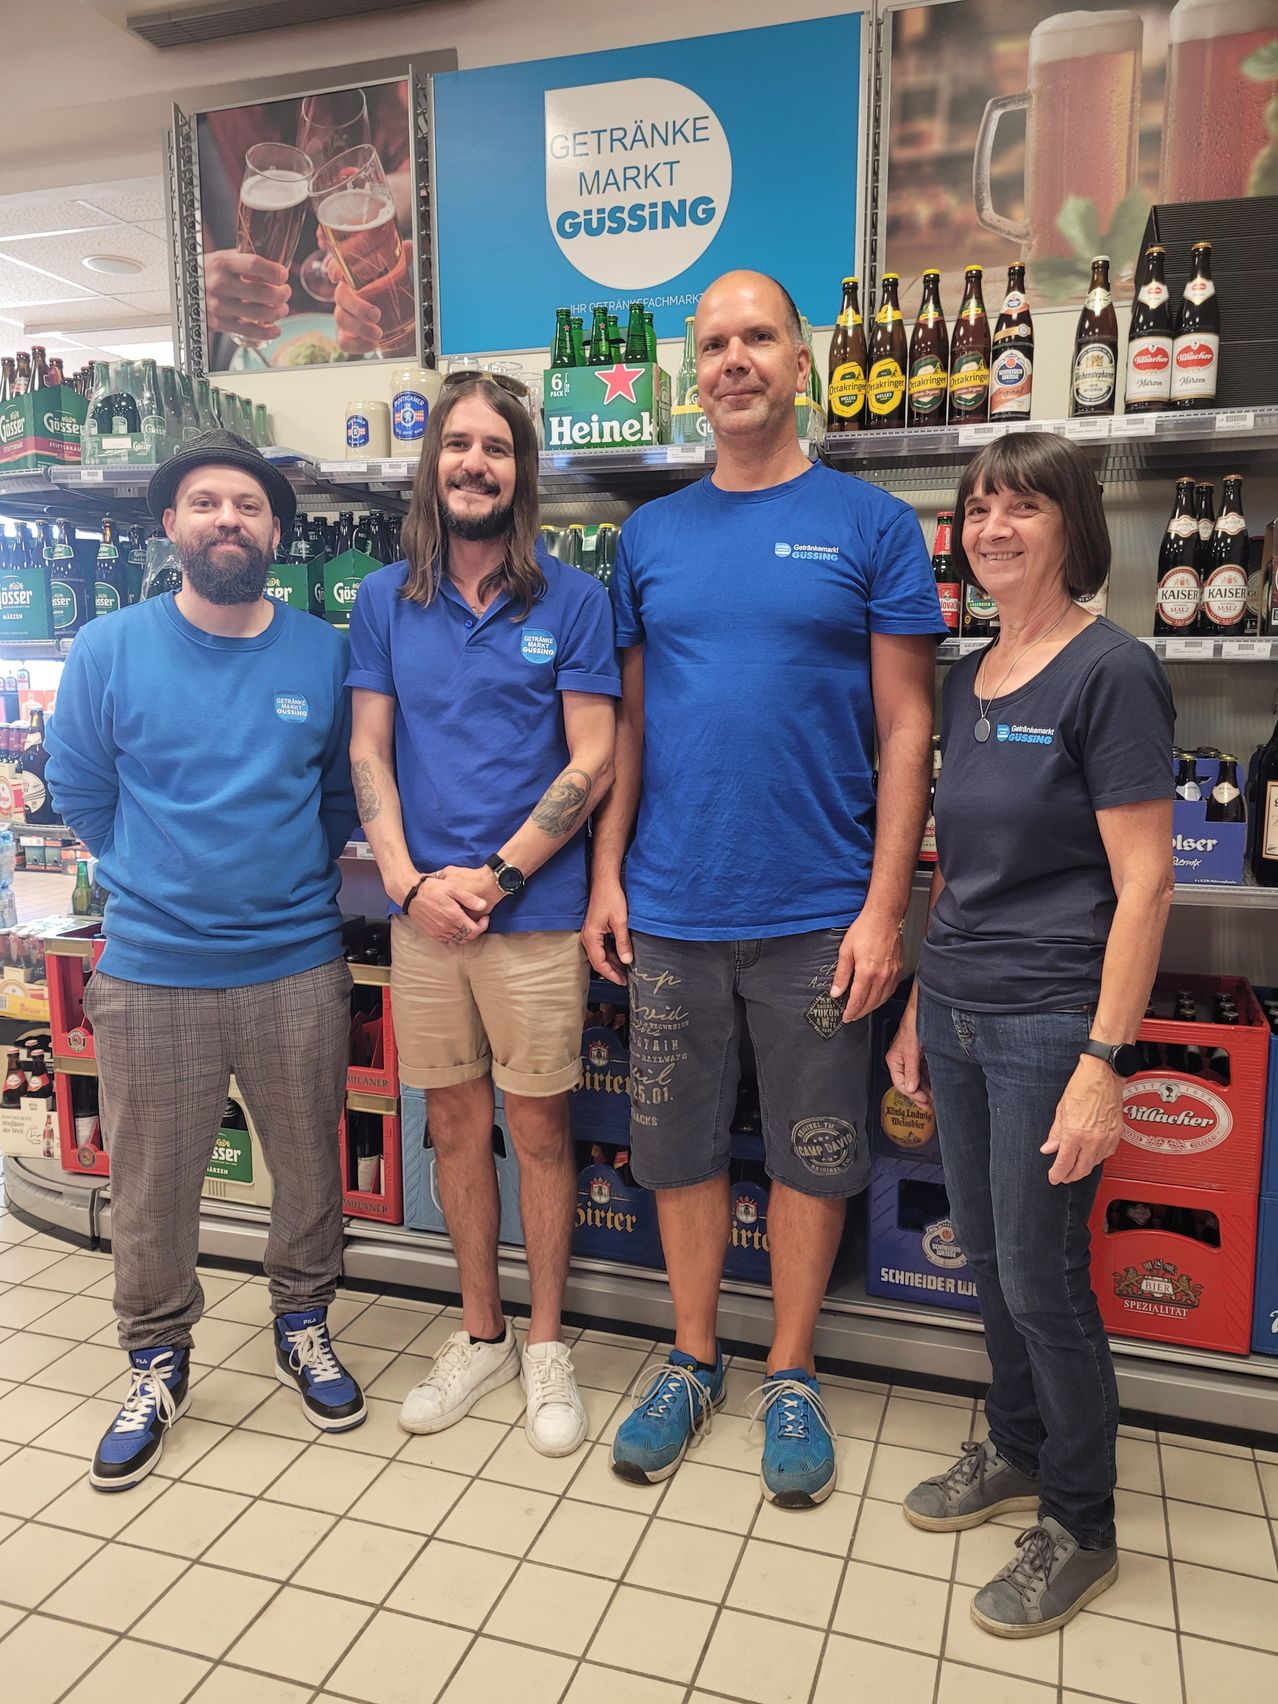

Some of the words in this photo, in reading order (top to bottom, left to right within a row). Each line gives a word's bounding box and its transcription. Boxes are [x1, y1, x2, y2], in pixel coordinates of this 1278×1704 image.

[550, 115, 710, 160] GETRÄNKE
[579, 160, 680, 196] MARKT
[570, 304, 587, 315] IHR
[551, 373, 562, 390] 6
[793, 543, 840, 554] Getränkemarkt
[1161, 589, 1199, 601] KAISER
[1207, 587, 1247, 599] KAISER
[1216, 604, 1238, 612] MALZ
[523, 635, 554, 644] GETRÄNKE
[527, 641, 550, 649] MARKT
[1011, 725, 1055, 735] Getränkemarkt
[813, 1008, 840, 1018] YUKON
[1123, 1104, 1214, 1128] Villacher
[798, 1145, 823, 1156] CAMP
[824, 1133, 853, 1153] DAVID
[881, 1268, 955, 1294] SCHNEIDER
[1145, 1281, 1170, 1292] BIER
[1124, 1300, 1188, 1317] SPEZIALITÄT
[303, 1317, 317, 1325] FILA
[135, 1357, 148, 1365] FILA
